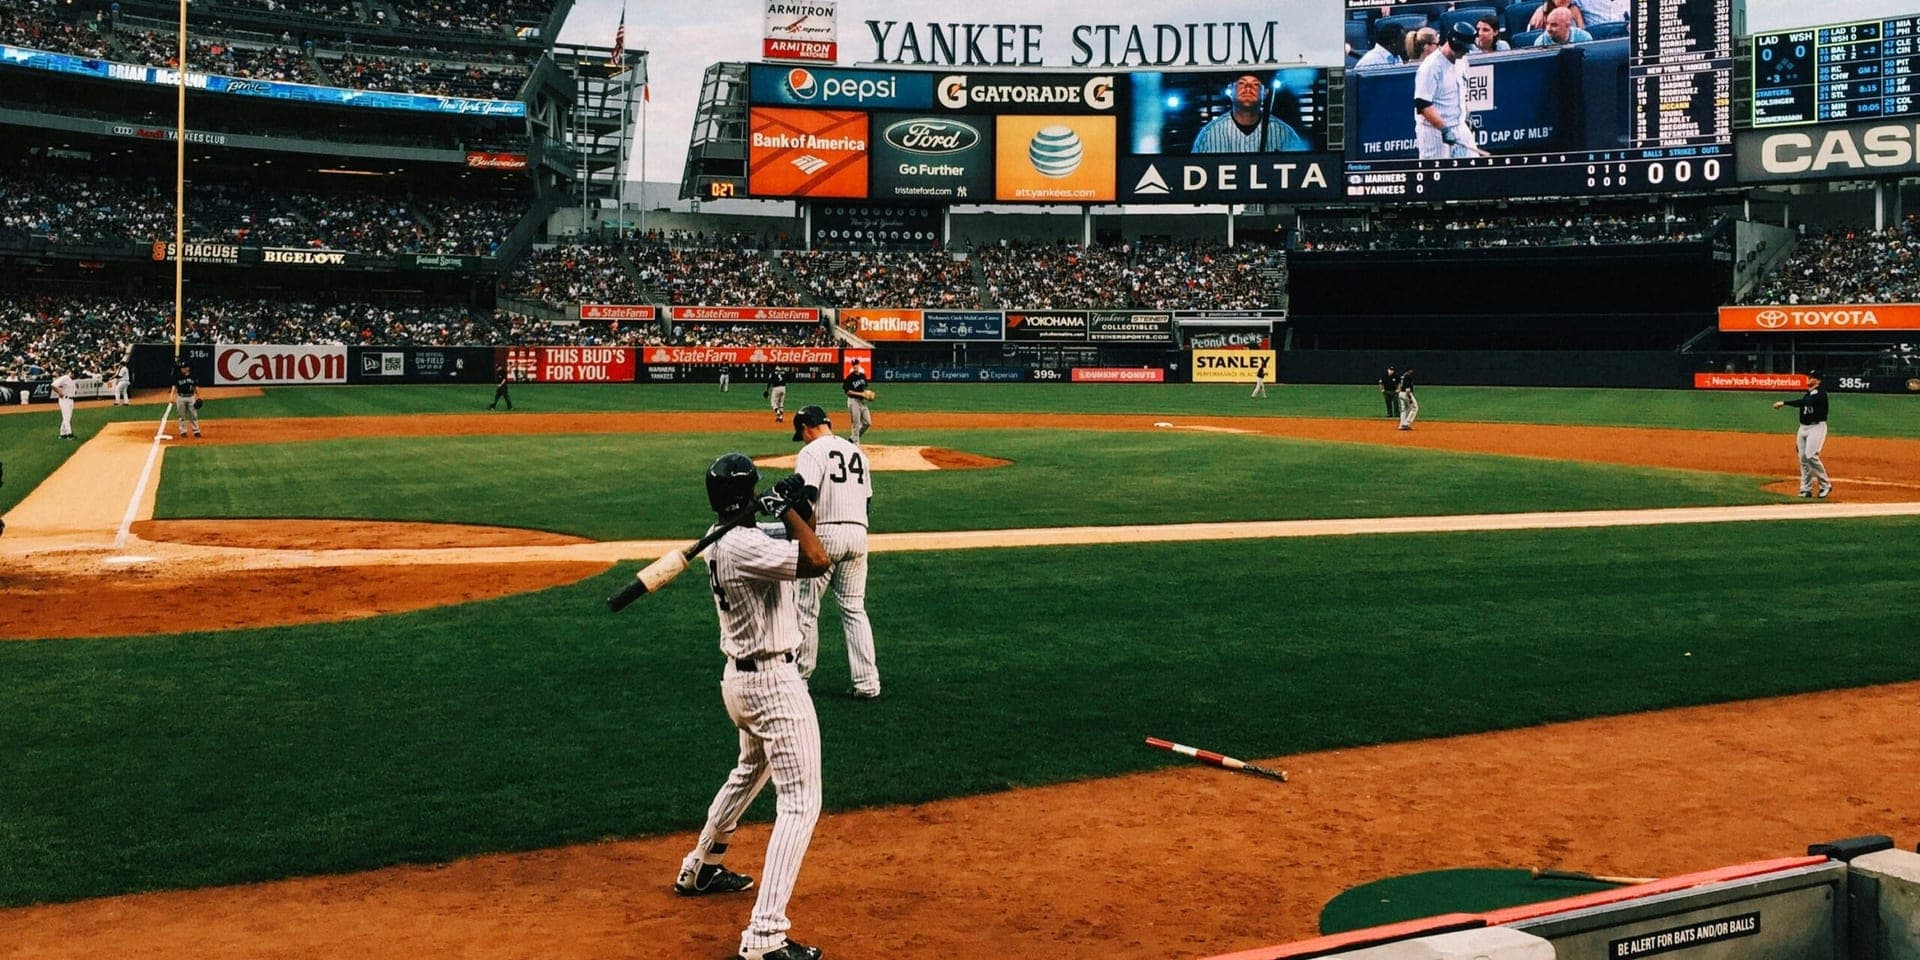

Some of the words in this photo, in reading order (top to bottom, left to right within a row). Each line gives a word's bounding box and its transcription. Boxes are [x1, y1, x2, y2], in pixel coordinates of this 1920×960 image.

[768, 4, 834, 17] ARMITRON
[1896, 19, 1911, 27] MIA
[1831, 28, 1846, 36] LAD
[1896, 27, 1910, 35] PHI
[864, 19, 1044, 68] YANKEE
[1071, 20, 1279, 68] STADIUM
[1759, 36, 1779, 46] LAD
[1789, 32, 1812, 43] WSH
[771, 41, 831, 54] ARMITRON
[1762, 48, 1772, 61] 0
[1795, 45, 1805, 58] 0
[1896, 46, 1911, 54] CIN
[1682, 63, 1711, 71] YANKEES
[1896, 58, 1909, 66] PIT
[108, 63, 147, 82] BRIAN
[1896, 66, 1911, 74] MIL
[823, 76, 897, 103] pepsi
[937, 75, 967, 110] G
[970, 85, 1082, 104] GATORADE
[1084, 75, 1114, 110] G
[1831, 91, 1846, 99] STL
[1896, 85, 1910, 93] ARI
[136, 128, 165, 139] Audi
[168, 131, 203, 143] YAKEES
[205, 133, 225, 145] CLUB
[753, 132, 790, 150] Bank
[790, 132, 806, 150] of
[806, 133, 865, 151] America
[902, 123, 961, 148] Ford
[1491, 131, 1511, 143] CAP
[1513, 129, 1526, 141] OF
[1364, 142, 1382, 153] THE
[1643, 150, 1663, 158] BALLS
[1669, 148, 1697, 157] STRIKES
[1702, 146, 1720, 154] OUTS
[1761, 124, 1920, 174] CAS
[467, 154, 527, 168] Budweiser
[899, 164, 918, 176] Go
[919, 164, 965, 177] Further
[1183, 163, 1328, 191] DELTA
[1365, 173, 1406, 183] MARINERS
[1416, 172, 1423, 182] 0
[1433, 171, 1440, 181] 0
[1587, 165, 1595, 175] 0
[1604, 164, 1609, 174] 1
[1619, 163, 1626, 173] 0
[1648, 162, 1664, 184] 0
[1675, 160, 1691, 182] 0
[1704, 159, 1720, 181] 0
[894, 187, 952, 196] tristateford.com
[1365, 185, 1405, 195] YANKEES
[1416, 184, 1423, 194] 0
[1587, 177, 1595, 187] 0
[1603, 177, 1611, 186] 0
[1619, 176, 1626, 185] 0
[1025, 316, 1085, 328] YOKOHAMA
[1792, 310, 1879, 326] TOYOTA
[861, 317, 920, 334] DraftKings
[1190, 336, 1227, 349] Peanut
[1228, 332, 1263, 347] Chews
[546, 349, 579, 364] THIS
[582, 349, 625, 364] BUD'S
[1196, 356, 1271, 369] STANLEY
[217, 348, 346, 382] Canon
[546, 365, 573, 380] FOR
[577, 365, 610, 380] YOU.
[894, 371, 922, 379] Experian
[941, 371, 970, 379] Experian
[990, 371, 1018, 379] Experian
[1120, 371, 1156, 379] DONUTS
[829, 450, 864, 484] 34
[1618, 942, 1629, 956] BE
[1630, 936, 1656, 954] ALERT
[1657, 933, 1674, 948] FOR
[1674, 930, 1695, 944] BATS
[1696, 922, 1729, 941] AND/OR
[1730, 917, 1755, 933] BALLS
